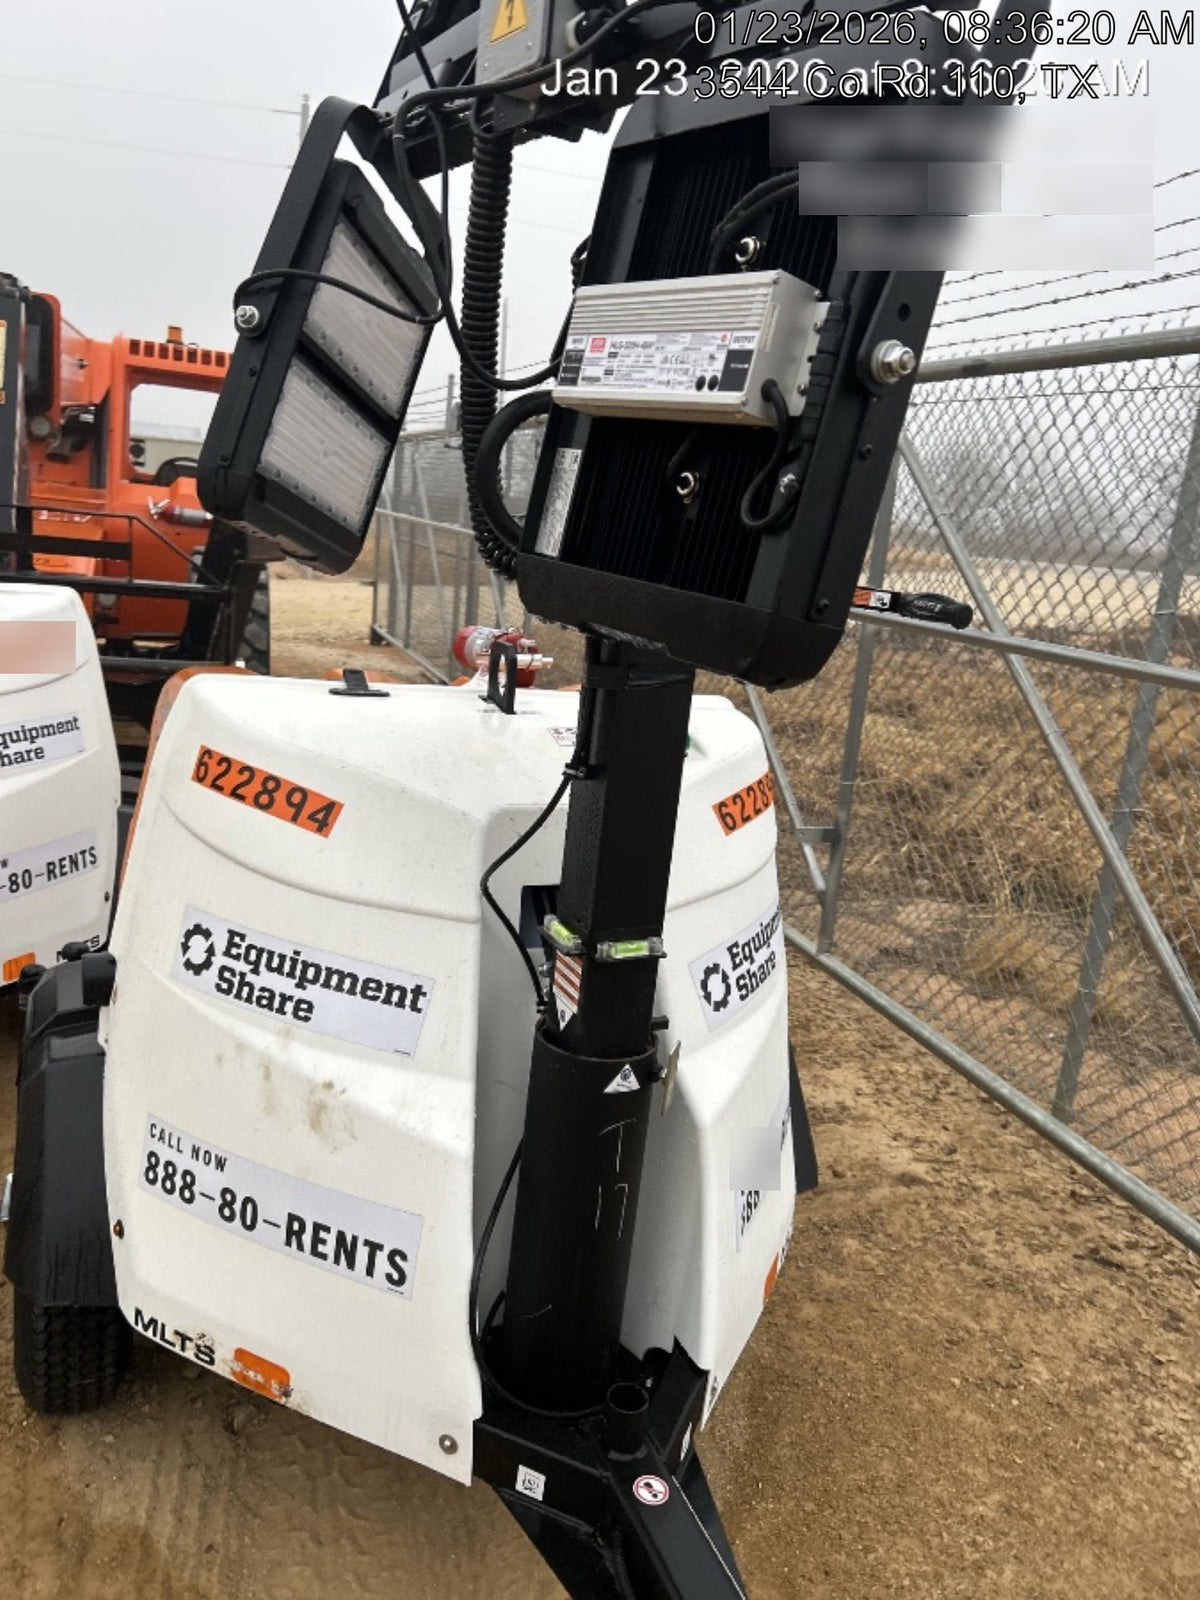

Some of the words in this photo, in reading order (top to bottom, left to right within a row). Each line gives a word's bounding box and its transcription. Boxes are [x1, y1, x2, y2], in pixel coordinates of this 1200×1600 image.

[193, 748, 336, 834] 622894
[214, 965, 315, 1024] Share
[221, 928, 428, 1014] Equipment
[735, 950, 777, 1002] Share
[149, 1122, 184, 1154] CALL
[191, 1143, 229, 1173] NOW
[143, 1150, 410, 1288] 888-80-RENTS
[133, 1305, 216, 1367] MLTS
